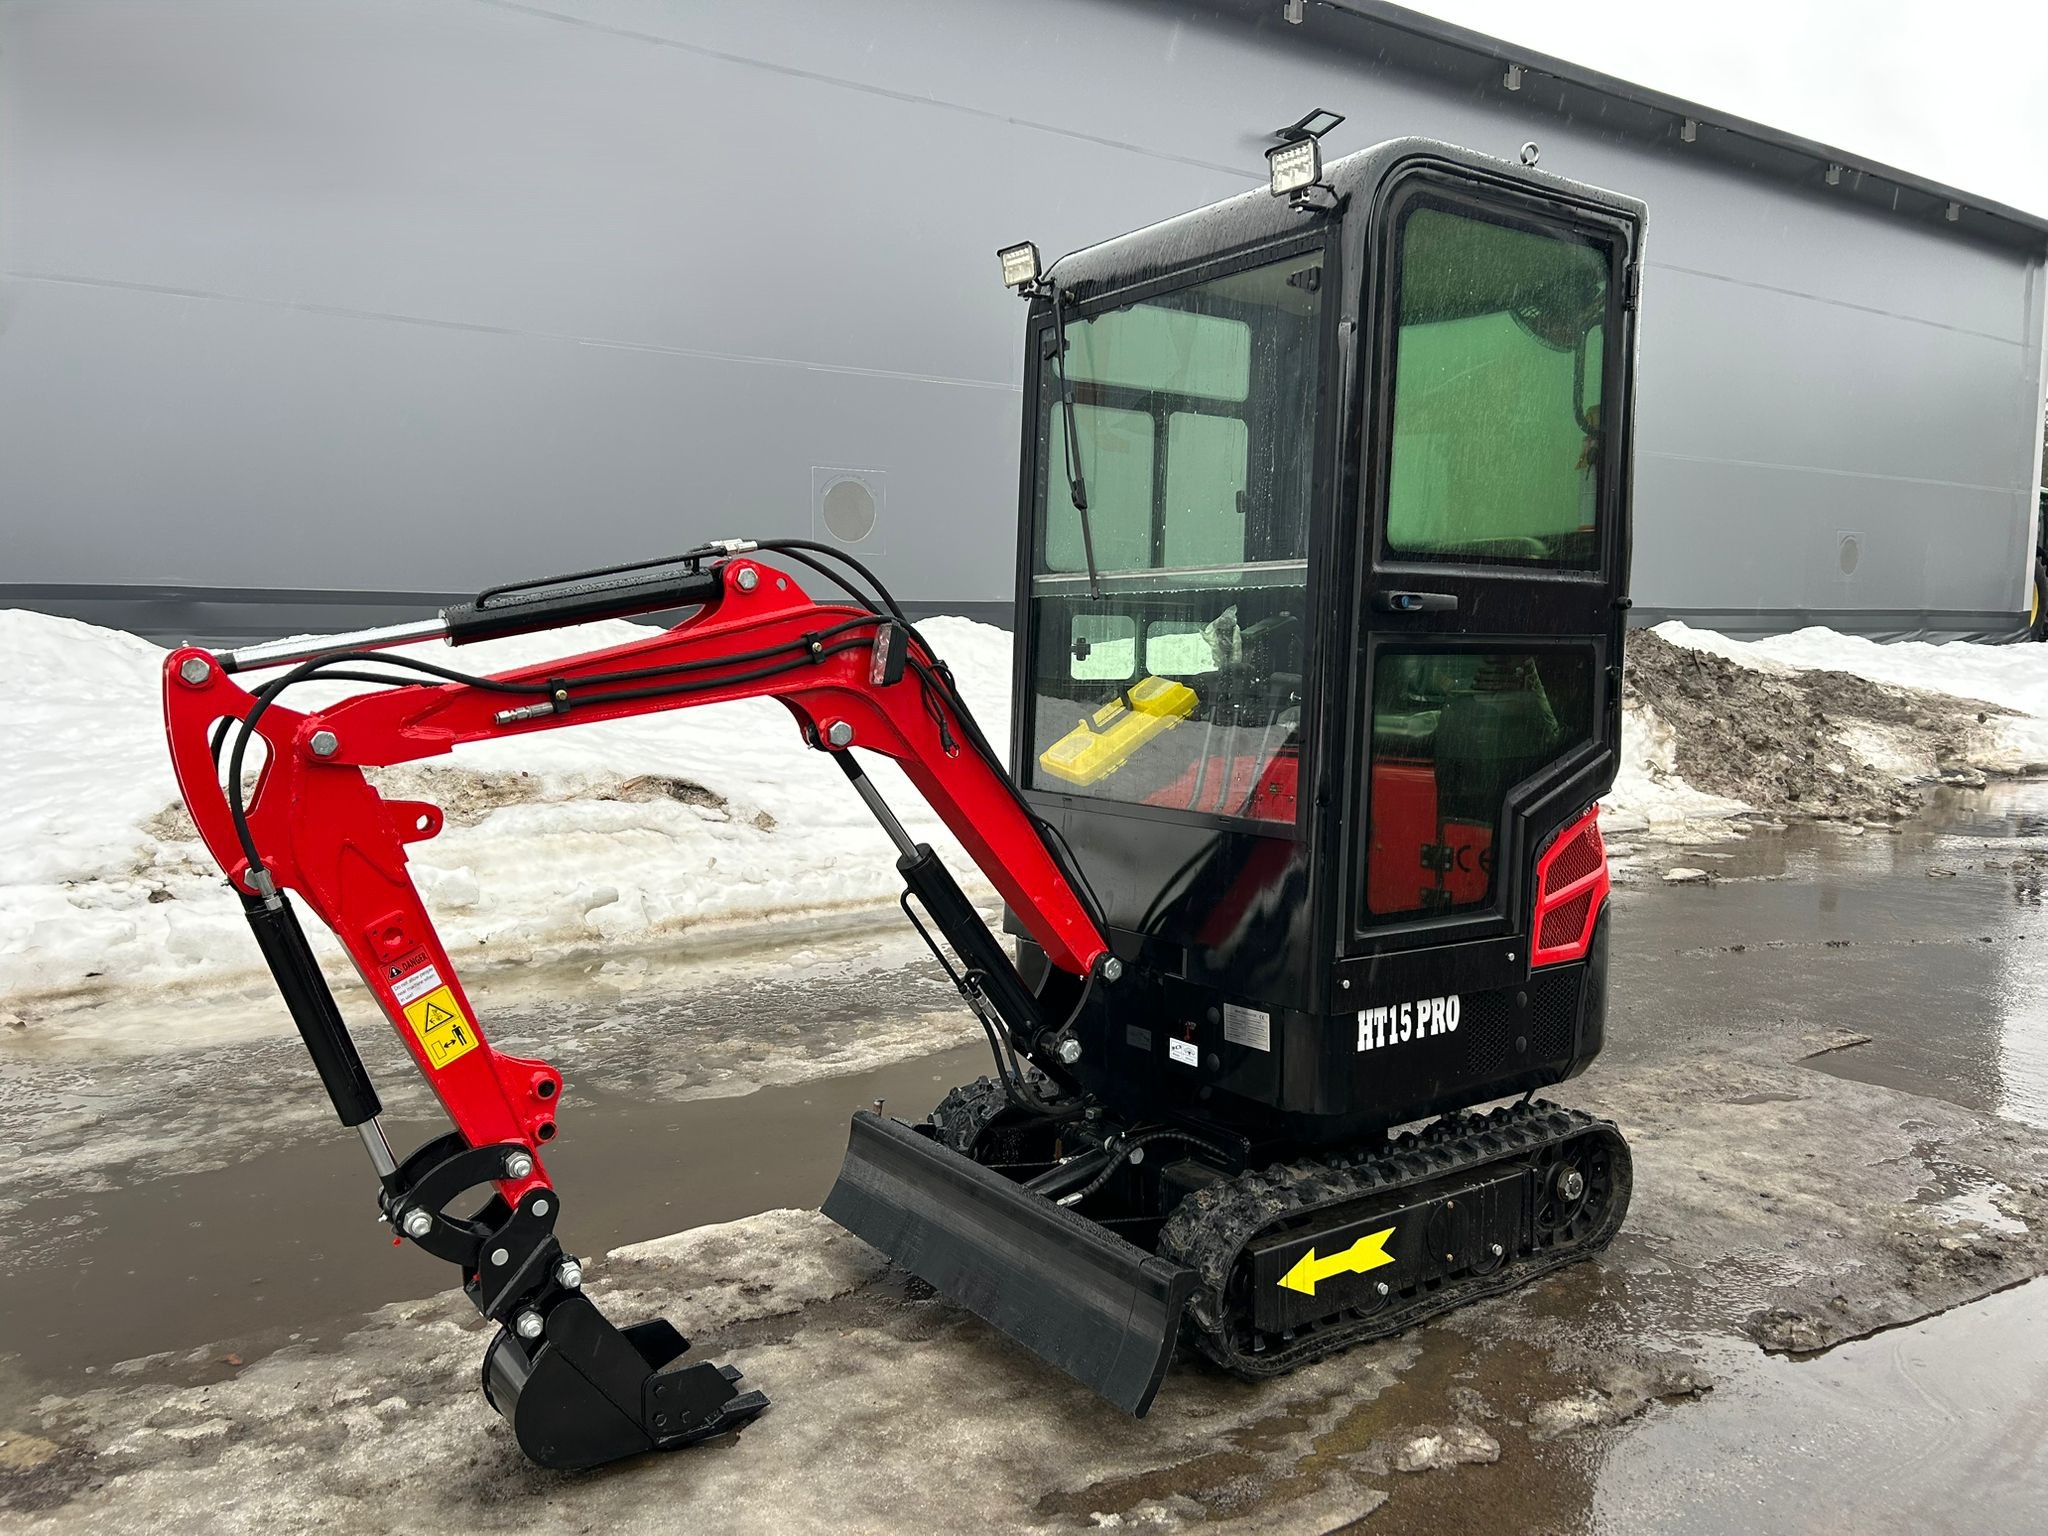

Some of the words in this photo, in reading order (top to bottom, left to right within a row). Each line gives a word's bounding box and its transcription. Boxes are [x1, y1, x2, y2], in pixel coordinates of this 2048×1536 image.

[401, 952, 427, 971] DANGER
[1357, 1002, 1412, 1052] HT15
[1416, 995, 1460, 1039] PRO
